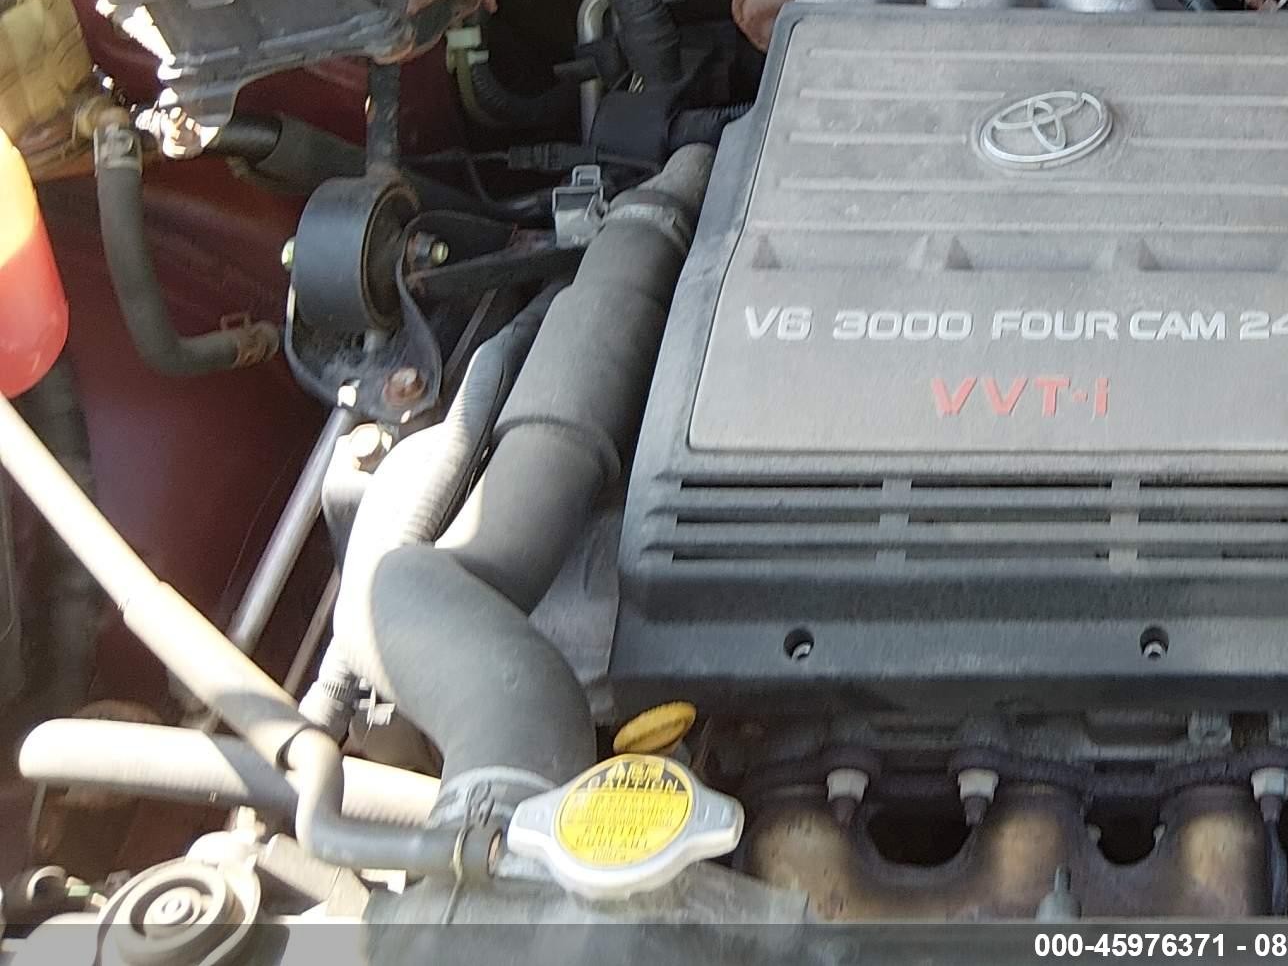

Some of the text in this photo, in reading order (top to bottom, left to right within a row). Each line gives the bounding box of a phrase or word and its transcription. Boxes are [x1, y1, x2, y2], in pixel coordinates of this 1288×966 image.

[745, 306, 812, 339] V6
[833, 311, 974, 340] 3000
[992, 311, 1118, 340] FOUR
[1129, 311, 1225, 340] CAM
[931, 377, 1110, 416] VVT-i
[587, 777, 679, 794] CAUTION
